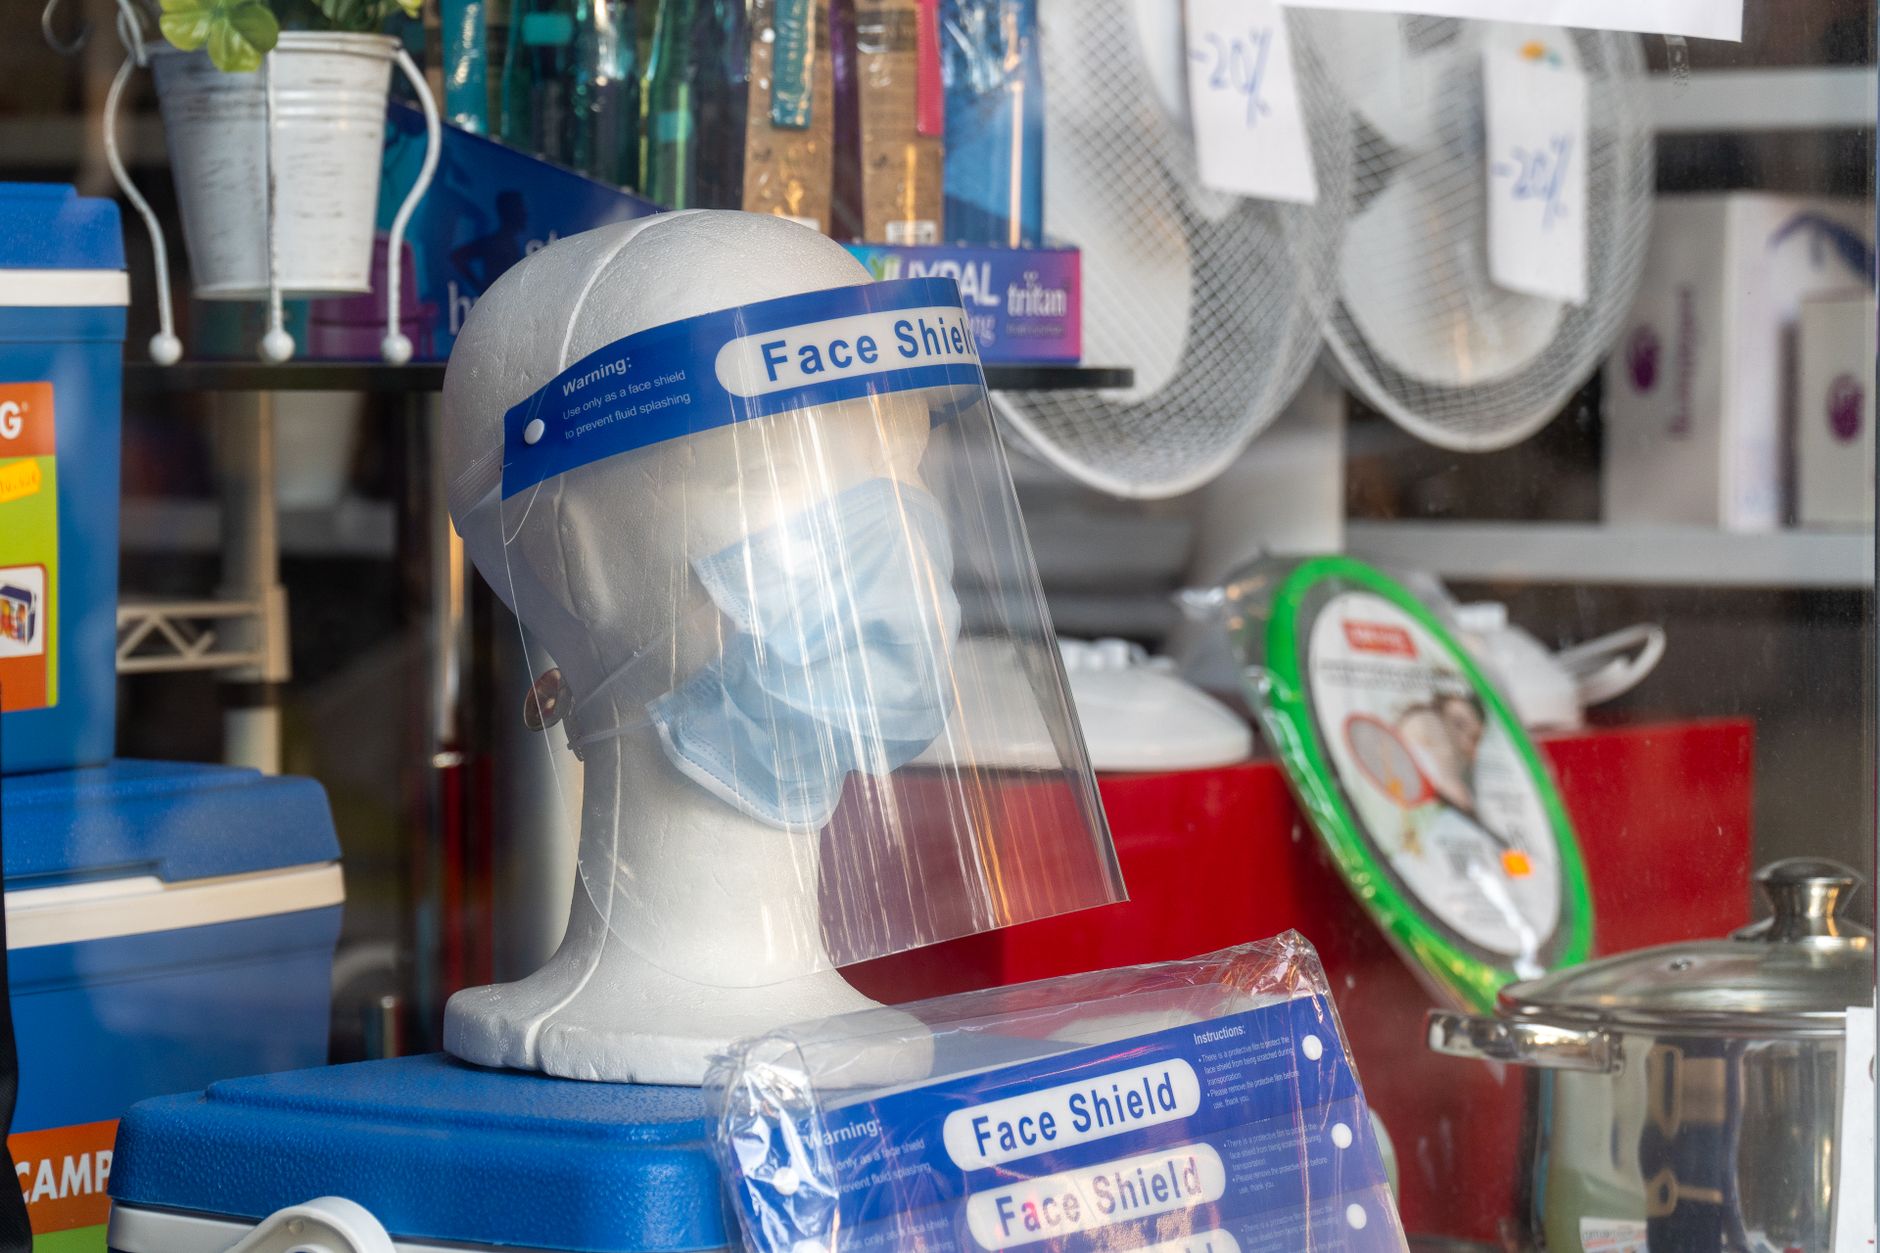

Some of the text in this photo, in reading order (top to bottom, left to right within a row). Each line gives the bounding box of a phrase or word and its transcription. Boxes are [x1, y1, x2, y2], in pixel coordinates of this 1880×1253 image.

[1188, 26, 1273, 130] -20%
[1490, 131, 1575, 235] -20%
[1007, 272, 1066, 316] tritan
[563, 357, 632, 397] Warning:
[761, 335, 878, 382] Face
[563, 370, 686, 420] Use only as a face shield
[565, 393, 691, 439] to prevent fluid splashing
[1194, 1025, 1246, 1044] Instructions:
[972, 1072, 1177, 1157] Face Shield
[995, 1157, 1202, 1237] Face Shield
